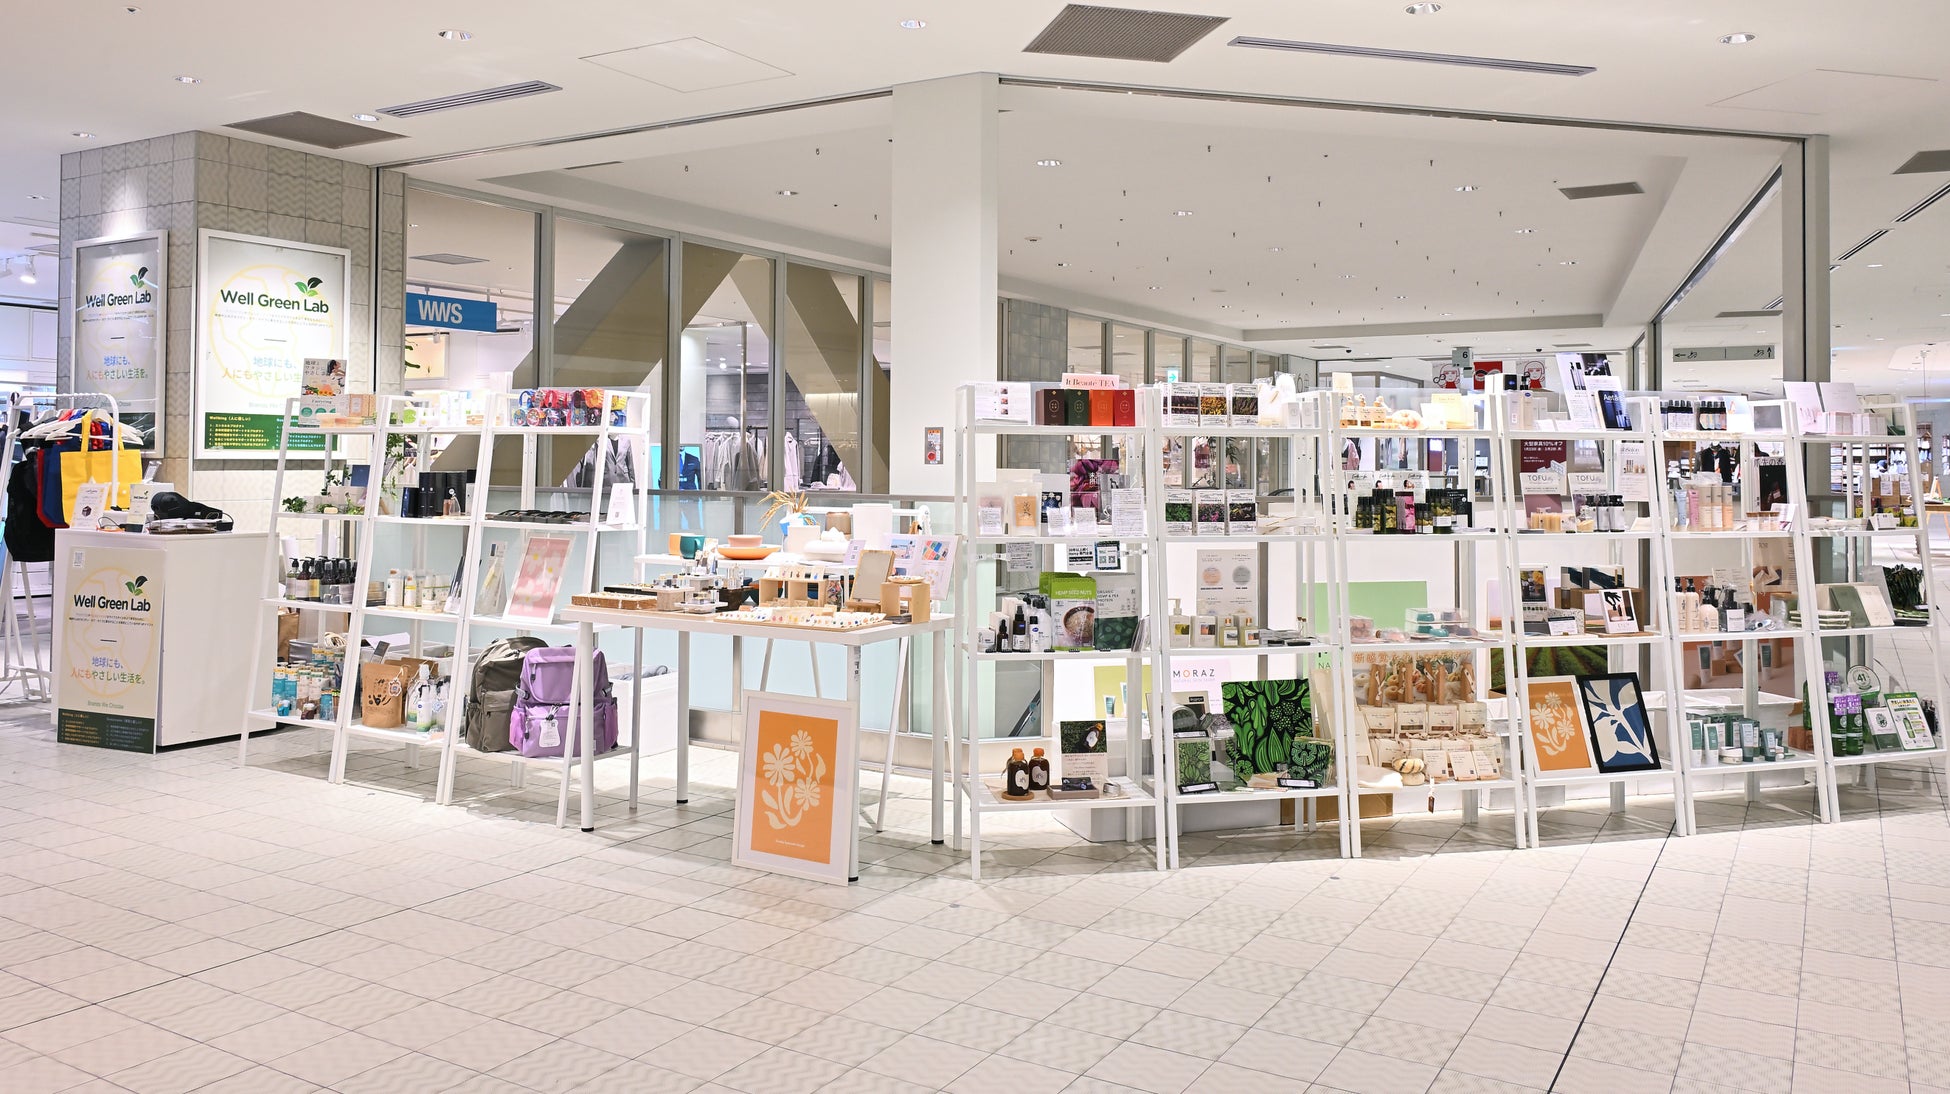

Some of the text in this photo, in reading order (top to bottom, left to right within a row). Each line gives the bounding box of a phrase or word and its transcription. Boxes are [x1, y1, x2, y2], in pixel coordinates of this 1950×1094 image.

[86, 291, 152, 308] Well Green Lab
[220, 289, 329, 313] Well Green Lab
[418, 299, 463, 324] WWS
[103, 355, 131, 366] 地球にも、
[1462, 351, 1468, 359] 6
[253, 356, 298, 369] 地球にも、
[86, 368, 148, 380] 人にもやさしい生活を。
[74, 594, 151, 612] Well Green Lab
[92, 655, 123, 669] 地球にも、
[70, 666, 145, 685] 人にもやさしい生活を。
[1172, 668, 1215, 678] MORAZ
